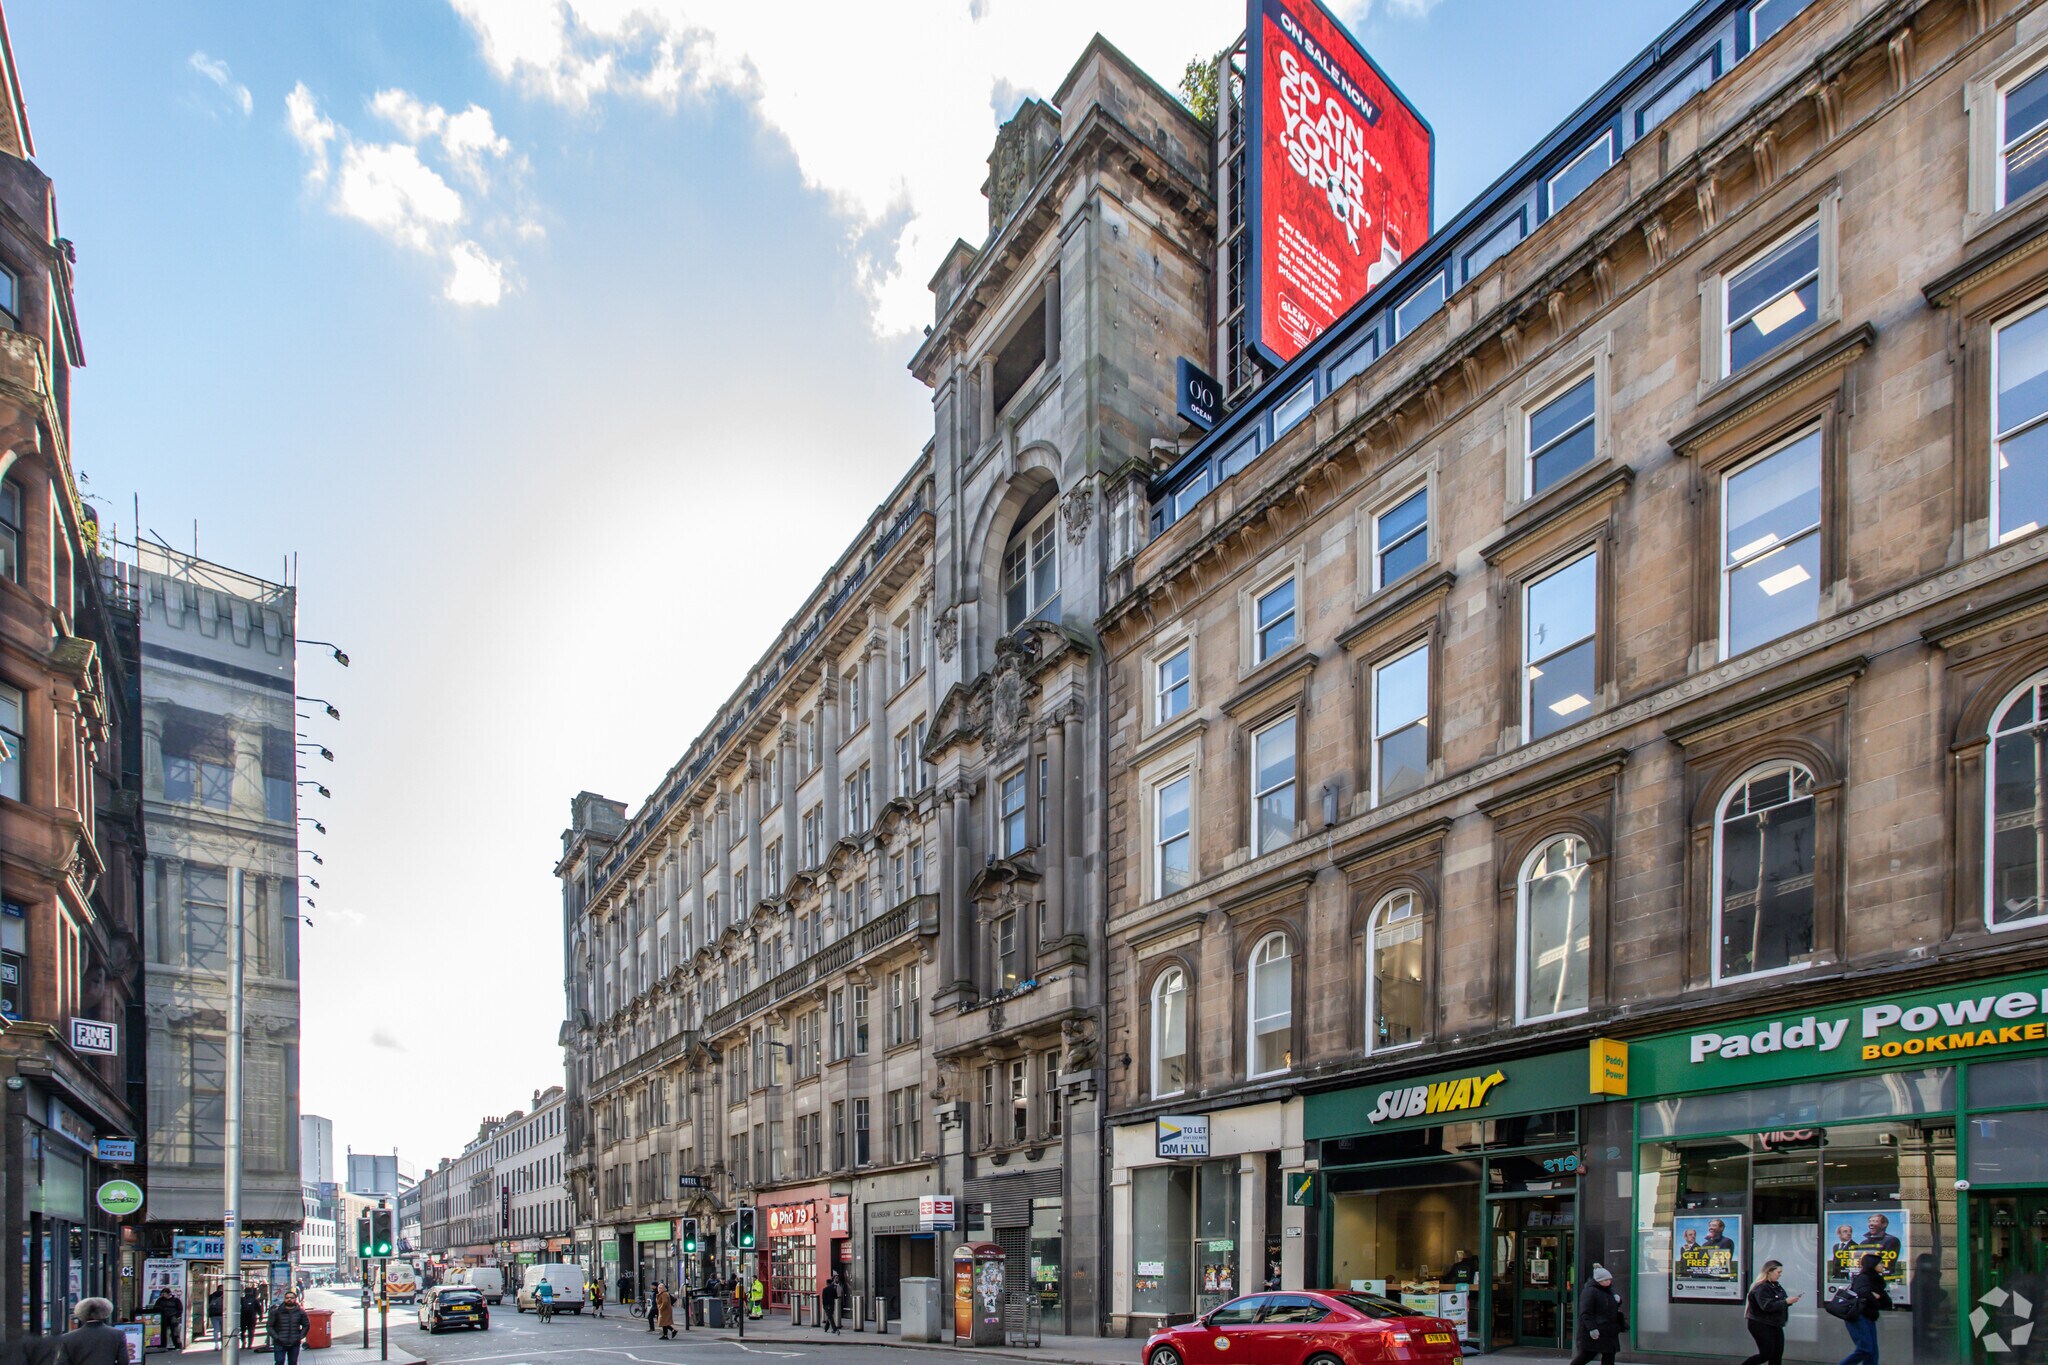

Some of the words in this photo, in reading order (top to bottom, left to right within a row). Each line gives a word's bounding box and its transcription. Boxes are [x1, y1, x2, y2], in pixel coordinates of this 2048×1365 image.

[1281, 13, 1303, 45] ON
[1304, 38, 1340, 85] SALE
[1341, 76, 1373, 118] NOW
[1280, 50, 1321, 105] GO
[1280, 76, 1364, 179] CLAIM
[1279, 97, 1364, 207] YOUR
[1285, 234, 1305, 256] make
[1305, 251, 1318, 267] the
[1278, 239, 1290, 255] for
[1296, 255, 1321, 284] chance
[1278, 264, 1301, 288] prizes
[1301, 283, 1315, 301] and
[1191, 404, 1213, 423] OCEAN
[77, 1024, 110, 1038] FINE
[1690, 1016, 1849, 1063] Paddy
[77, 1035, 110, 1049] HOLM
[1862, 1022, 2048, 1060] BOOKMAKE
[1606, 1055, 1624, 1068] Paddy
[1606, 1069, 1624, 1080] Power
[1367, 1069, 1505, 1124] SUBWAY
[1194, 1126, 1207, 1134] LET
[1162, 1144, 1178, 1154] DM
[1181, 1144, 1207, 1154] HALL
[796, 1208, 806, 1223] 79
[831, 1203, 847, 1232] H
[204, 1243, 254, 1254] REPRS
[1682, 1251, 1700, 1259] GET
[1702, 1251, 1709, 1259] A
[1713, 1251, 1731, 1259] £20
[1835, 1250, 1856, 1259] GET
[1709, 1259, 1726, 1268] BET
